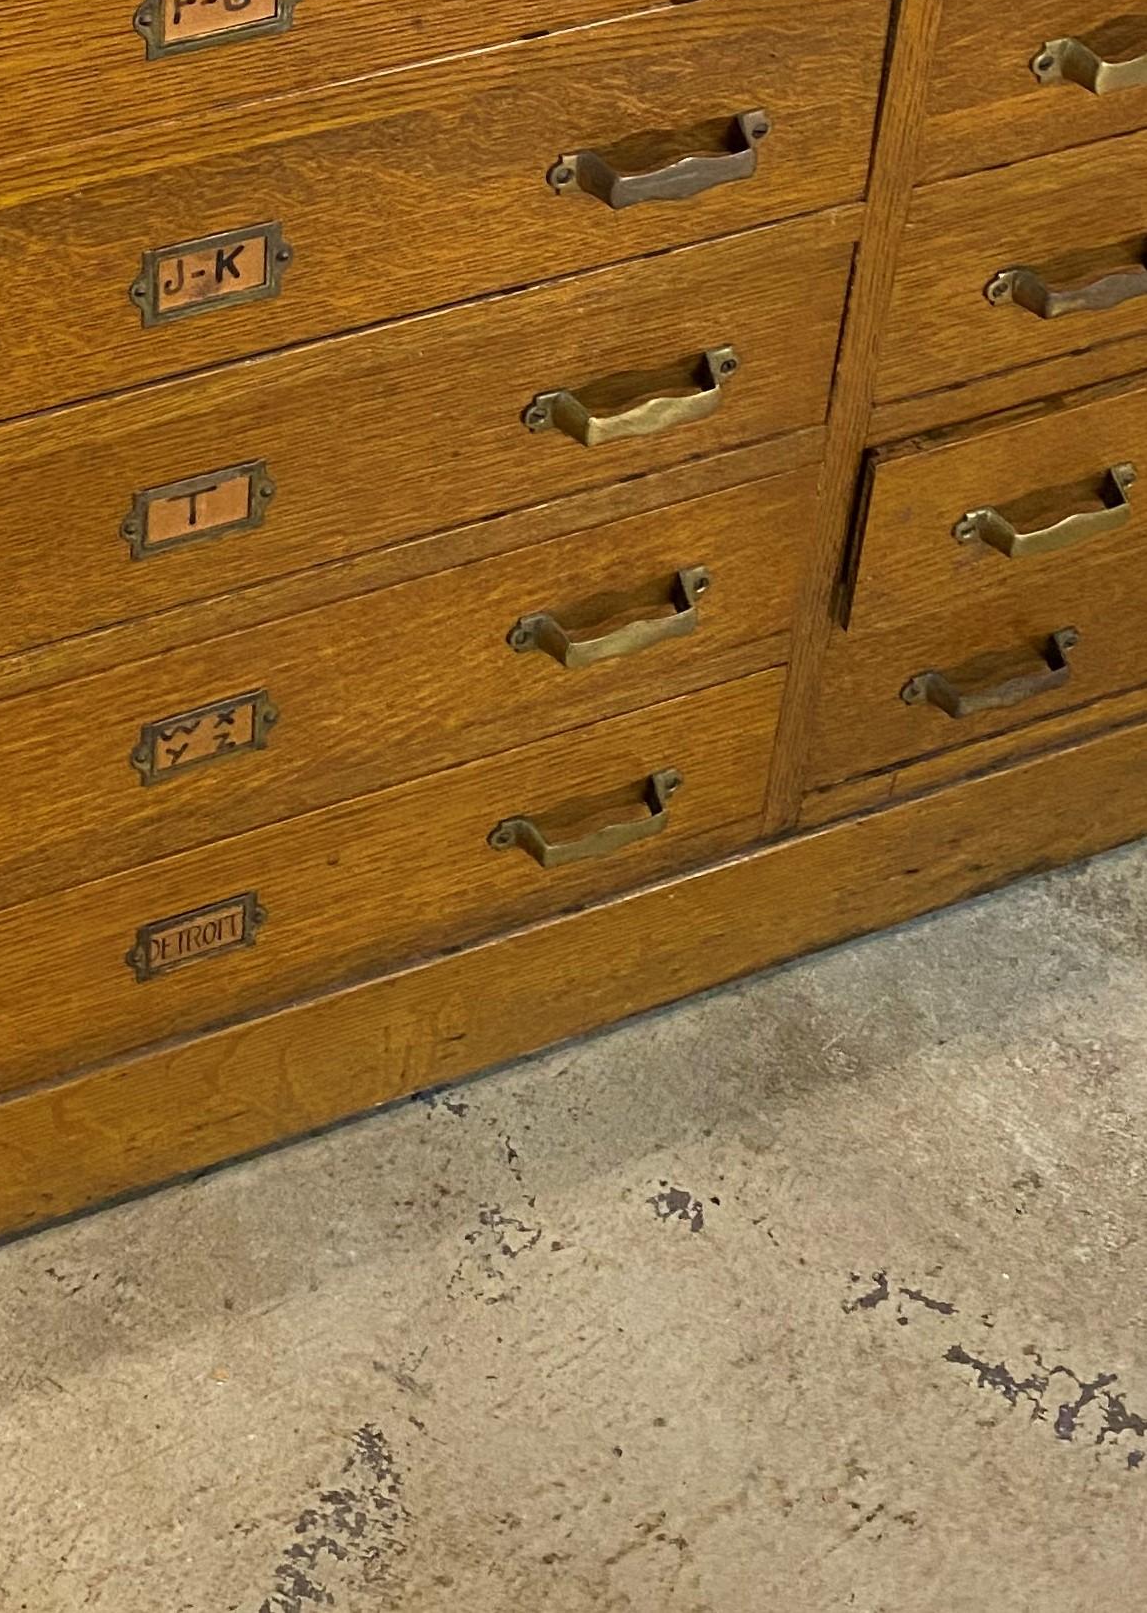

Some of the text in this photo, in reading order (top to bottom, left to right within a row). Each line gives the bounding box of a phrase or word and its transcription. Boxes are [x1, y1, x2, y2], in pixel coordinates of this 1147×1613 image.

[163, 245, 245, 295] J-K
[166, 485, 217, 524] T
[150, 913, 242, 961] DETROIT
